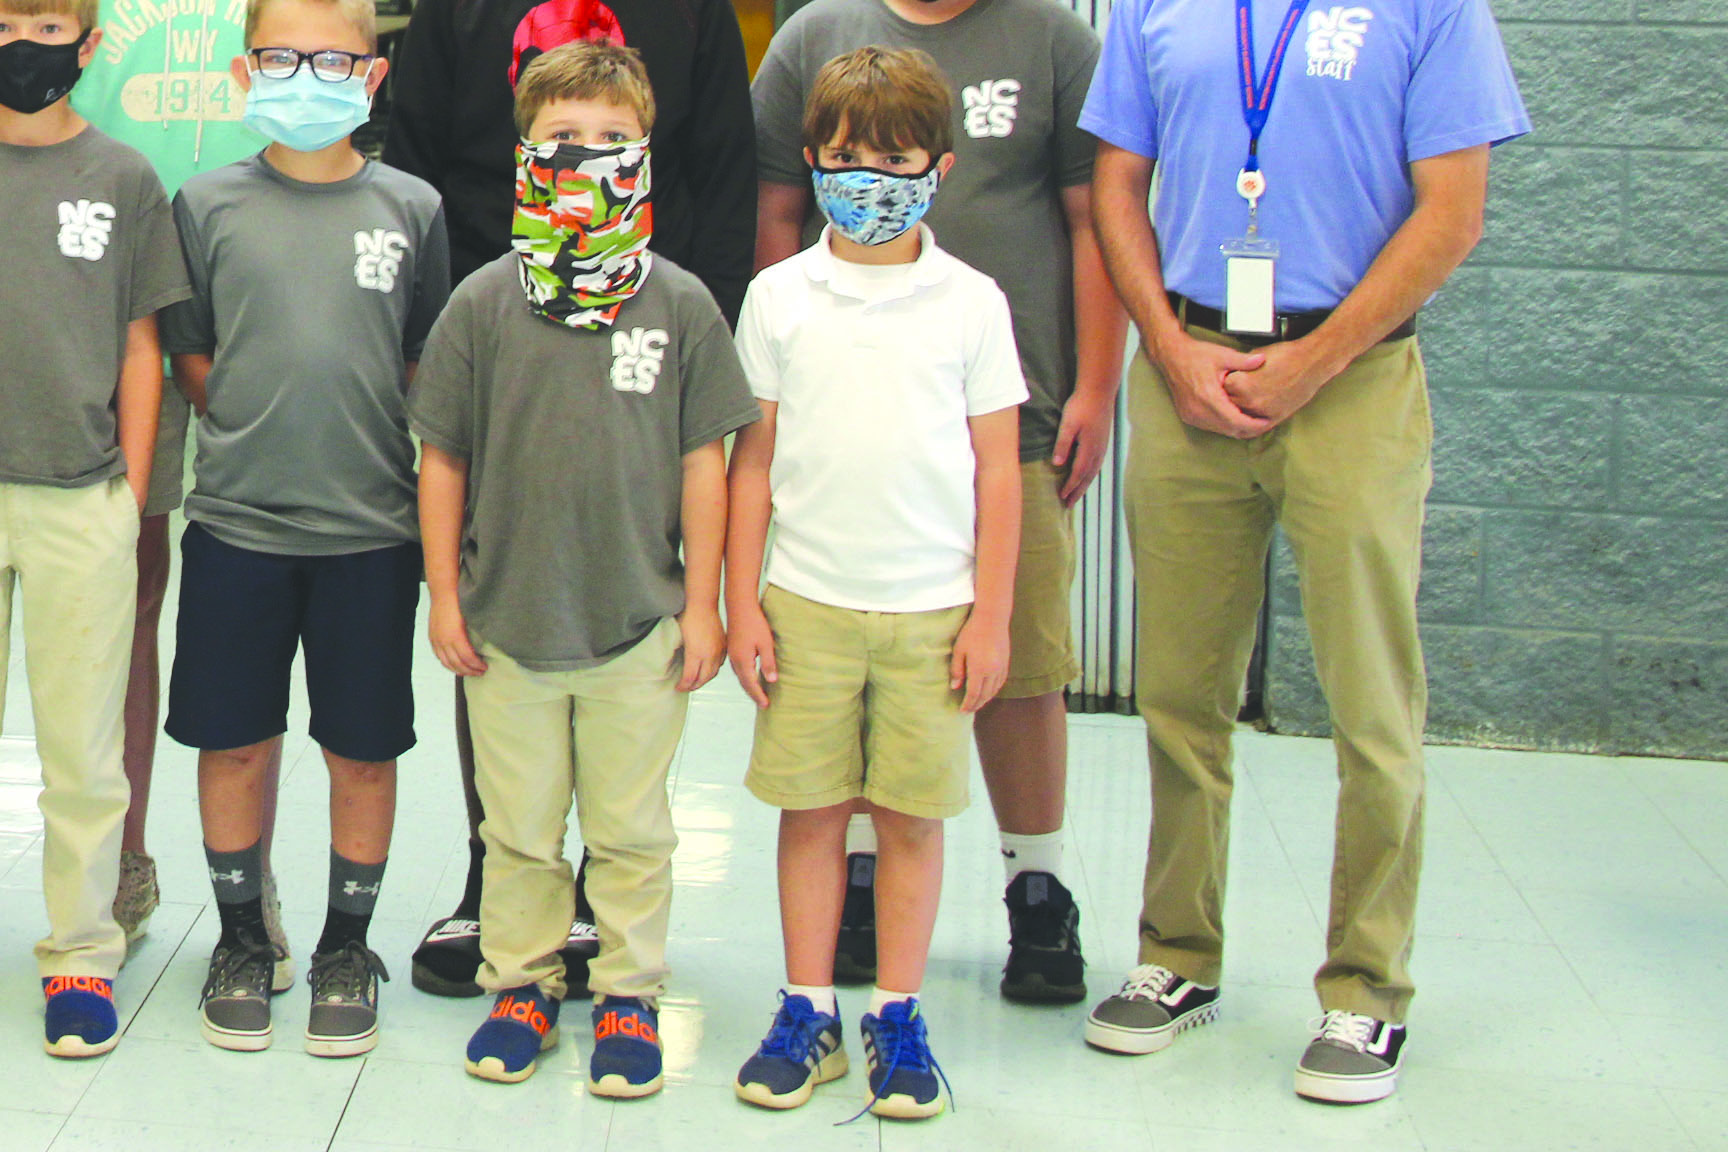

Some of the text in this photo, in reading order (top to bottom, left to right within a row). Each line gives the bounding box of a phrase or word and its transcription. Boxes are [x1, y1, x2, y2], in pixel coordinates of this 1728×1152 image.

[1307, 6, 1374, 34] NC
[173, 29, 218, 64] WY
[154, 78, 231, 115] 1914
[961, 79, 1021, 109] NC
[963, 105, 1017, 138] ES
[57, 198, 116, 233] NC
[57, 224, 109, 261] ES
[353, 228, 409, 262] NC
[353, 254, 399, 293] ES
[611, 327, 669, 360] NC
[609, 354, 661, 394] ES
